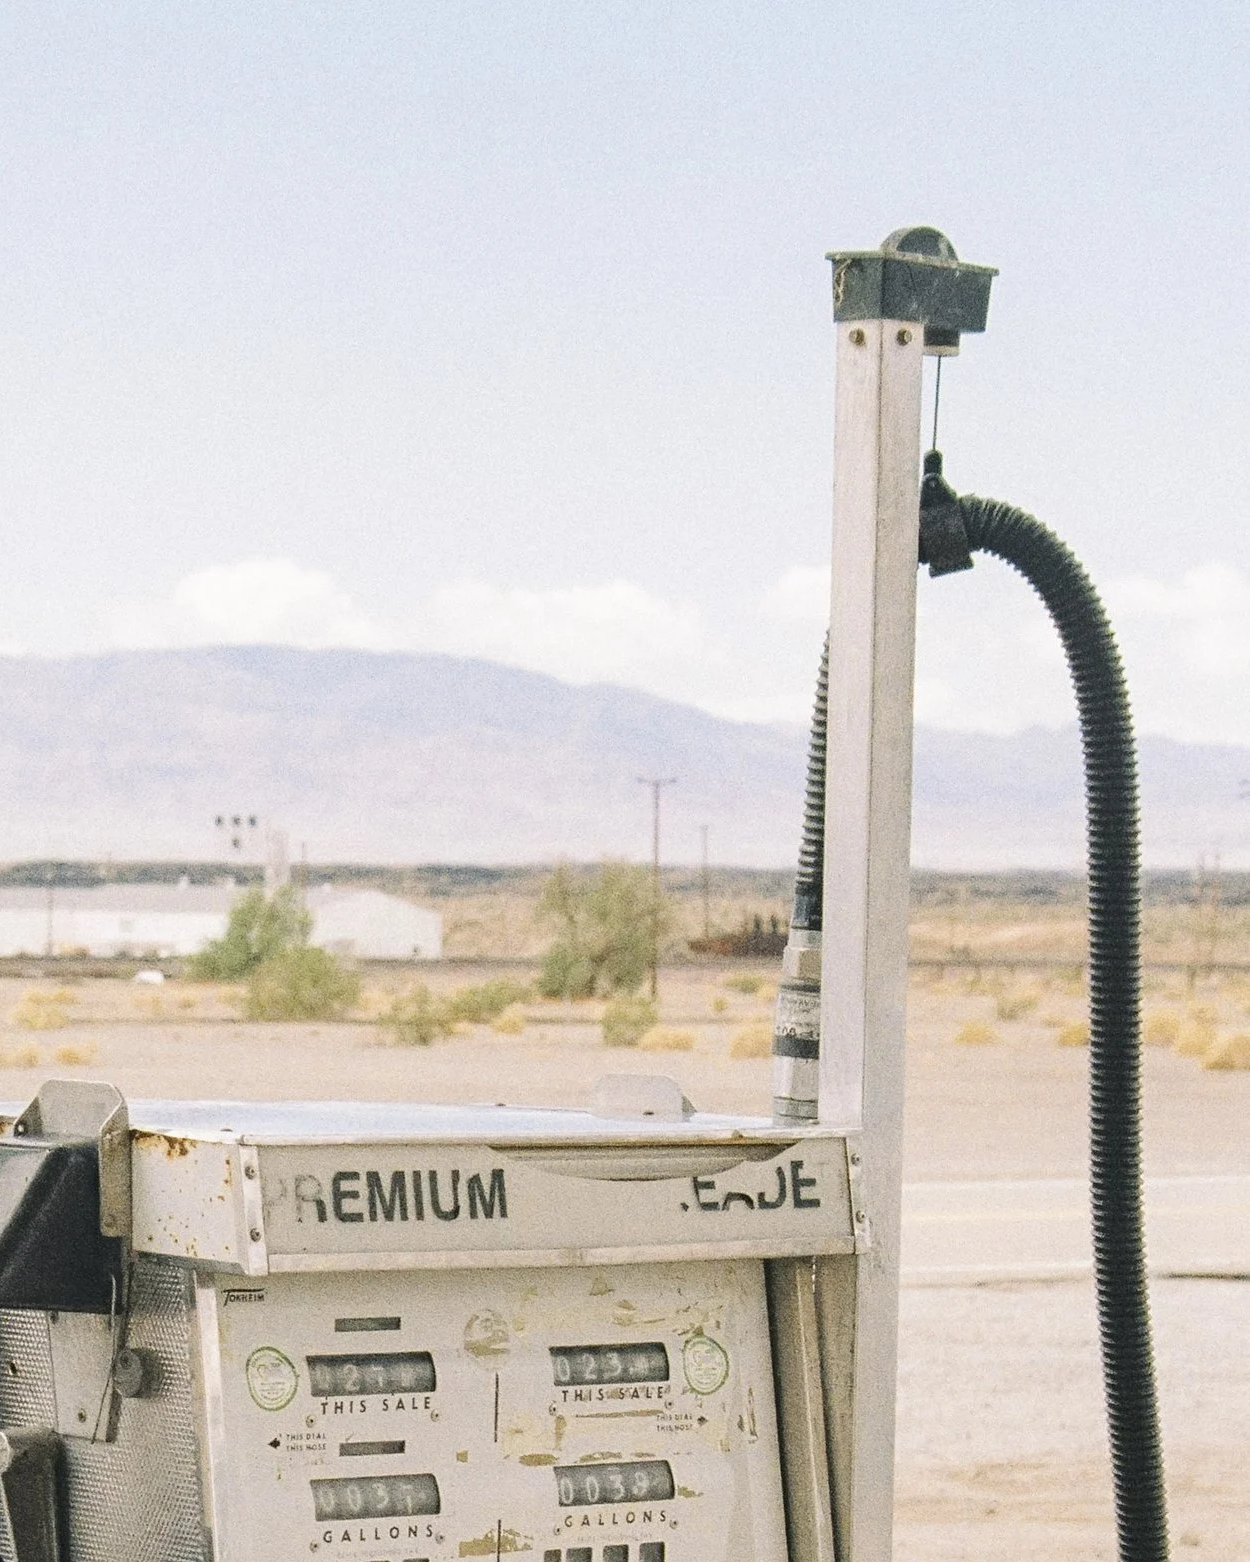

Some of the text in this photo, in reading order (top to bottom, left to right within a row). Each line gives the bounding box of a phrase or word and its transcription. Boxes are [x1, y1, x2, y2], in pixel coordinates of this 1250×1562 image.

[562, 1386, 664, 1402] THIS SALE
[321, 1397, 431, 1415] THIS SALE
[565, 1510, 666, 1527] GALLONS
[323, 1525, 432, 1543] GALLONS
